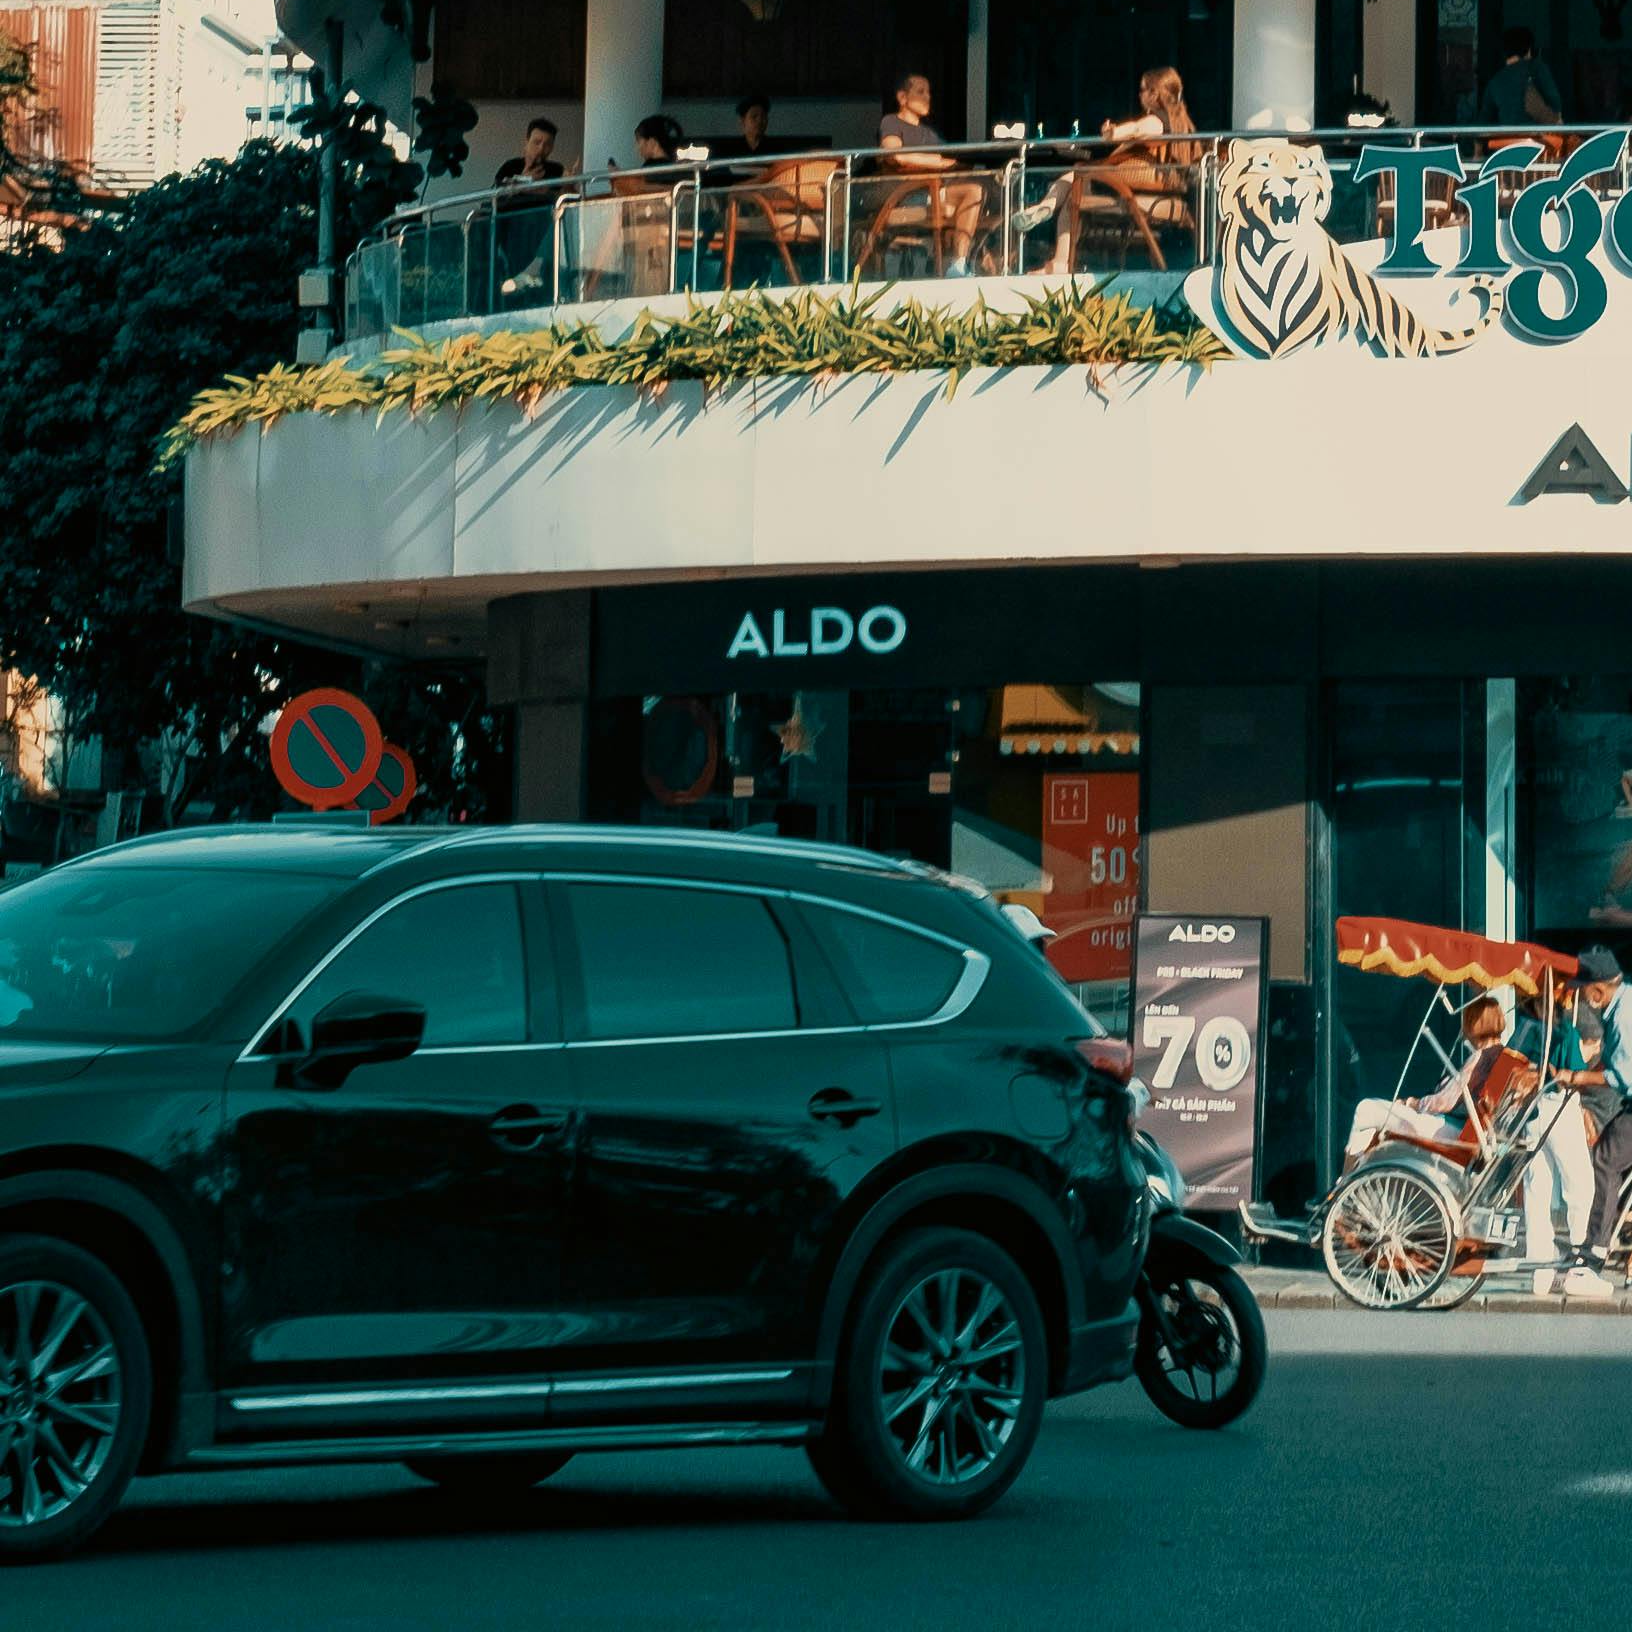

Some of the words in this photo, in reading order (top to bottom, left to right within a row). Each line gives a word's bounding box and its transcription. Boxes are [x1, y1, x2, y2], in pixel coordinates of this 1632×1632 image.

[727, 605, 906, 658] ALDO
[1106, 814, 1126, 837] Up
[1169, 924, 1236, 943] ALDO
